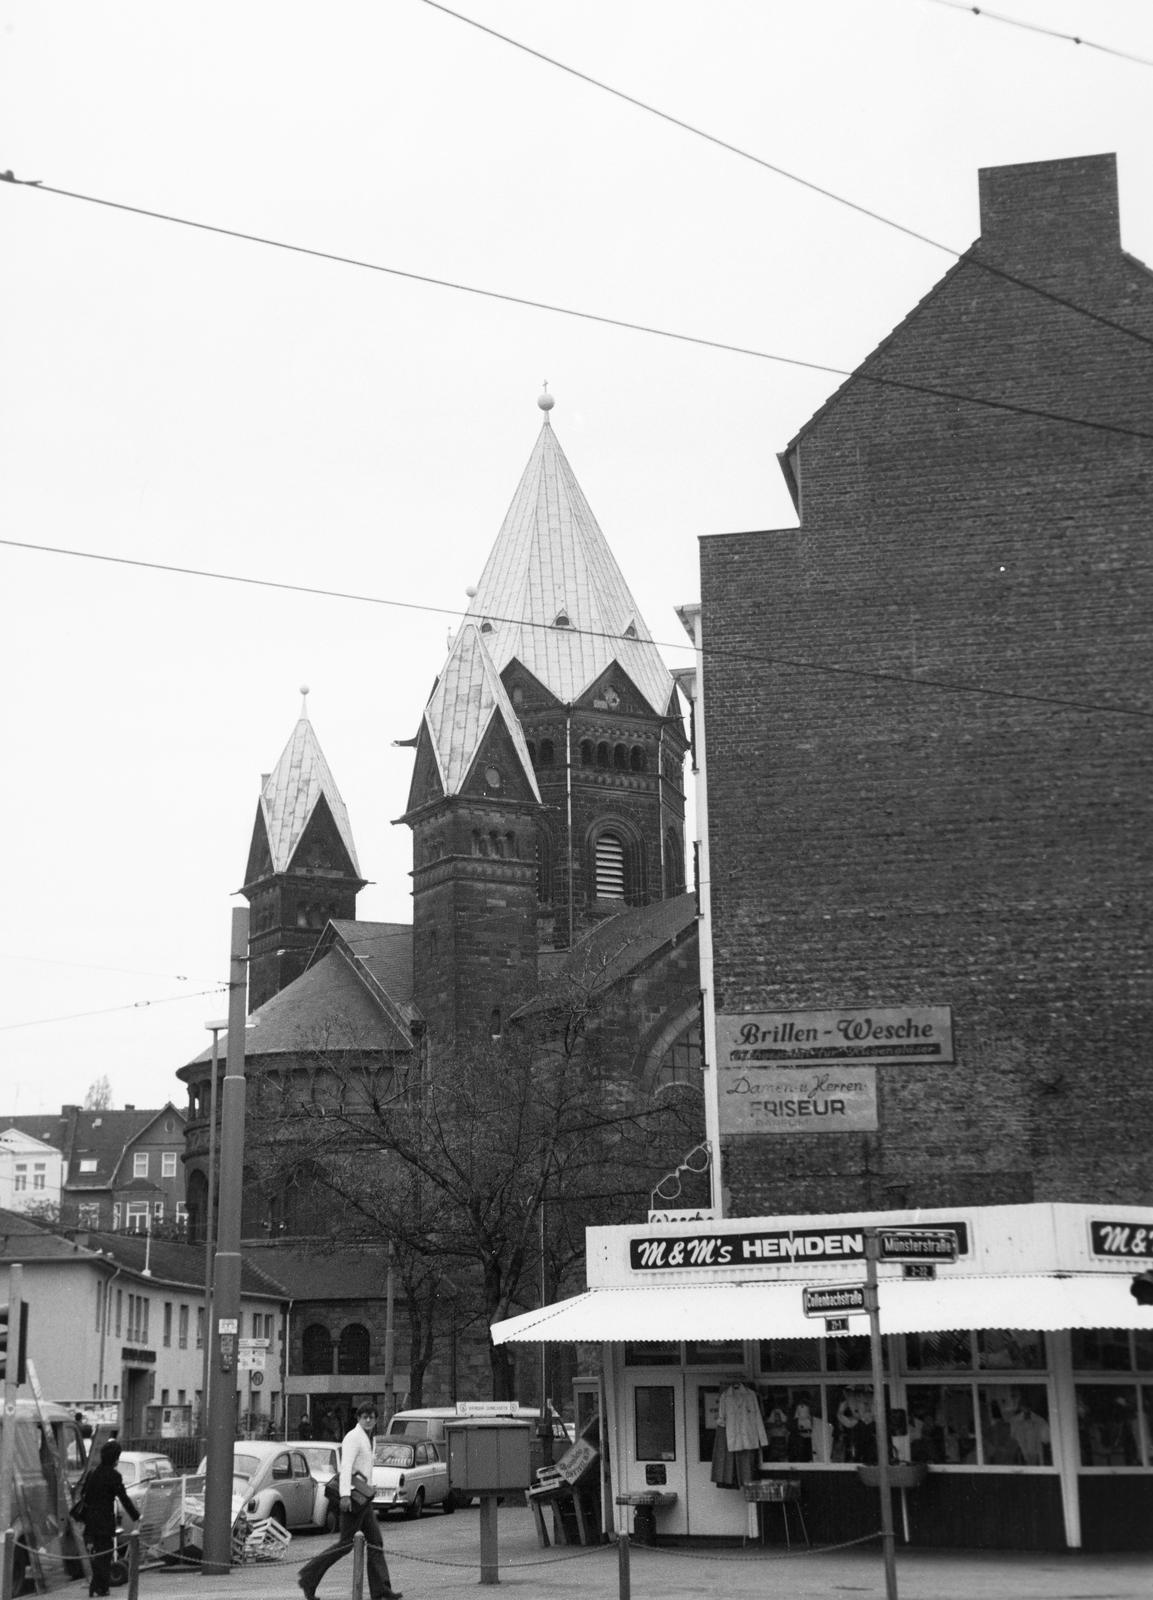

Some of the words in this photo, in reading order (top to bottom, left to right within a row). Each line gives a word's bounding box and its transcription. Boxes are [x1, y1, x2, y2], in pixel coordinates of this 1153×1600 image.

[734, 1022, 818, 1046] Brillen
[837, 1017, 933, 1041] Wesche
[750, 1099, 846, 1117] FRISEUR
[742, 1234, 864, 1258] HEMDEN
[884, 1237, 952, 1252] Münsterstraße
[1100, 1225, 1153, 1254] M&
